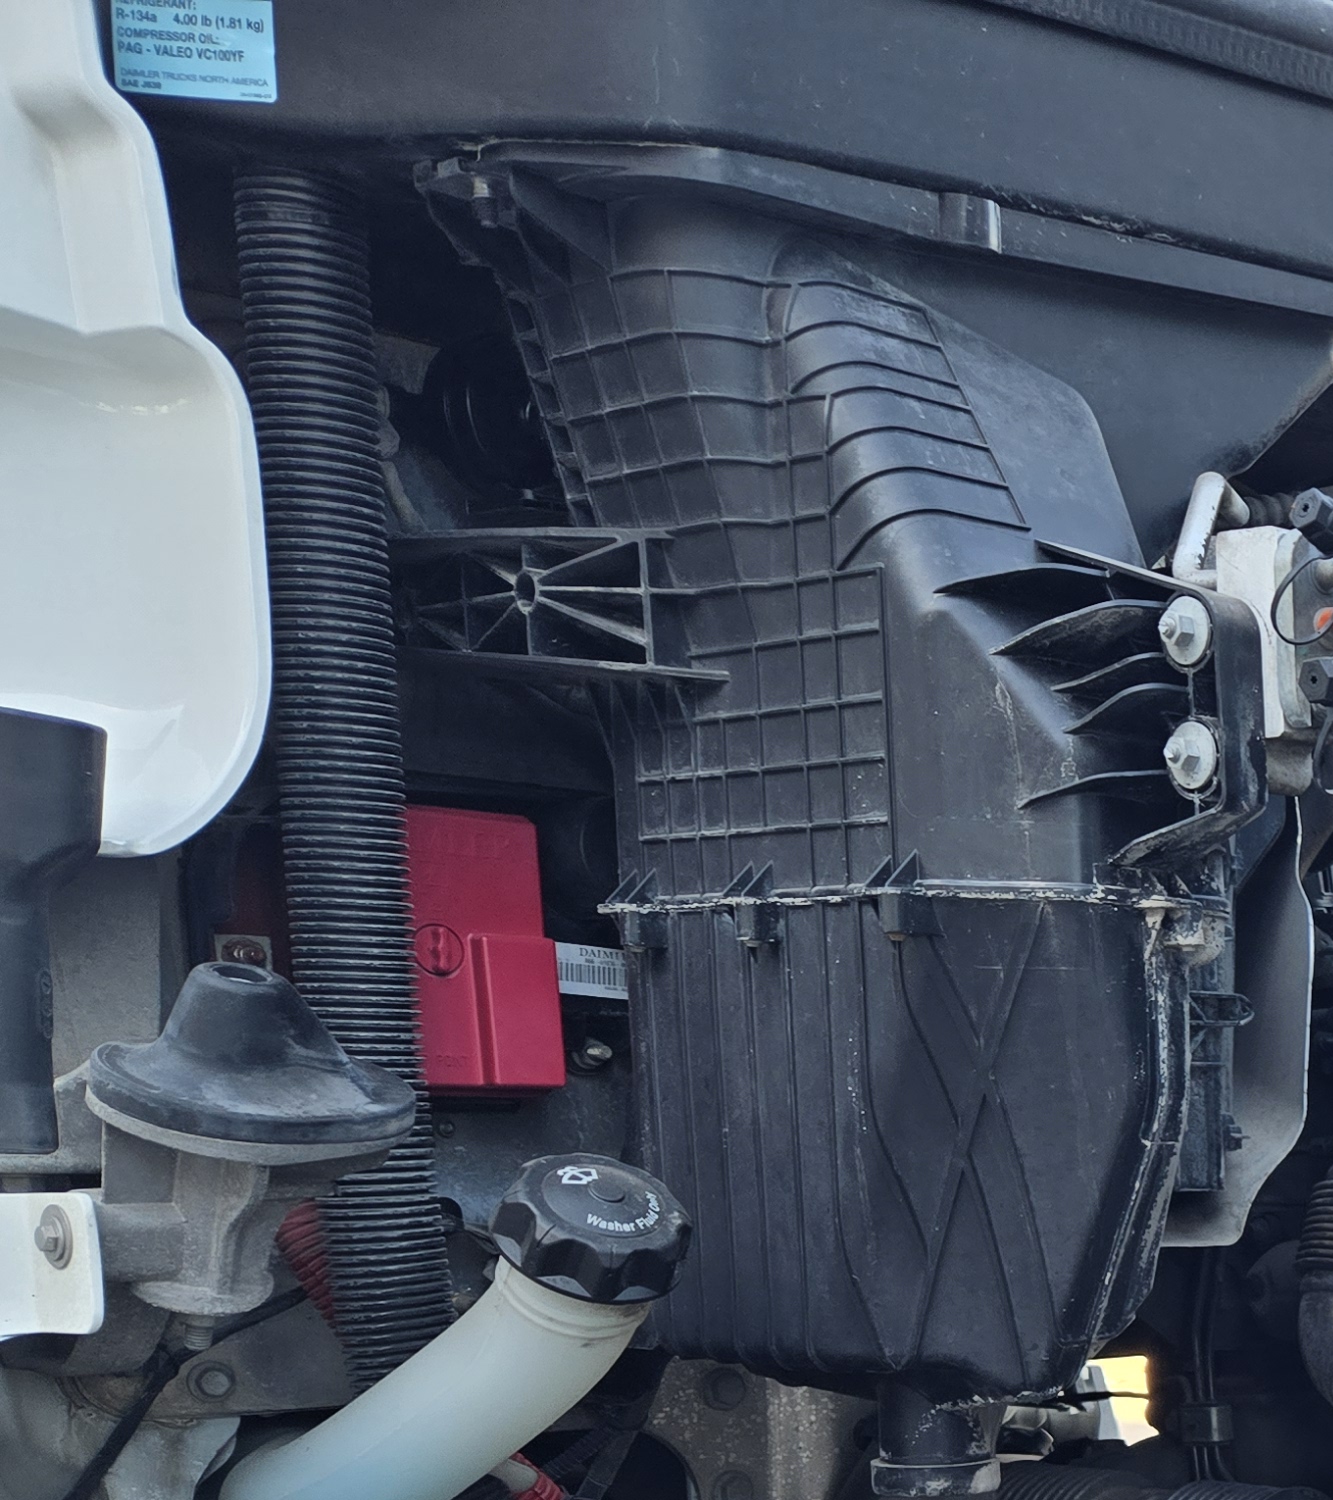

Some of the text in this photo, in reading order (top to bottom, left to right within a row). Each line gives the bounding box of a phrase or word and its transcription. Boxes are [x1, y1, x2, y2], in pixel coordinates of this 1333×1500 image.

[115, 7, 264, 33] R-134a 4.00 lb (1.81 kg)
[116, 26, 196, 43] COMPRESSOR
[118, 41, 143, 55] PAG
[154, 44, 193, 59] VALEO
[196, 48, 245, 62] VC100YF
[120, 68, 268, 87] DAIMLER TRUCKS NORTH AMERICA
[586, 1213, 635, 1232] Washer
[635, 1210, 659, 1230] Fluid
